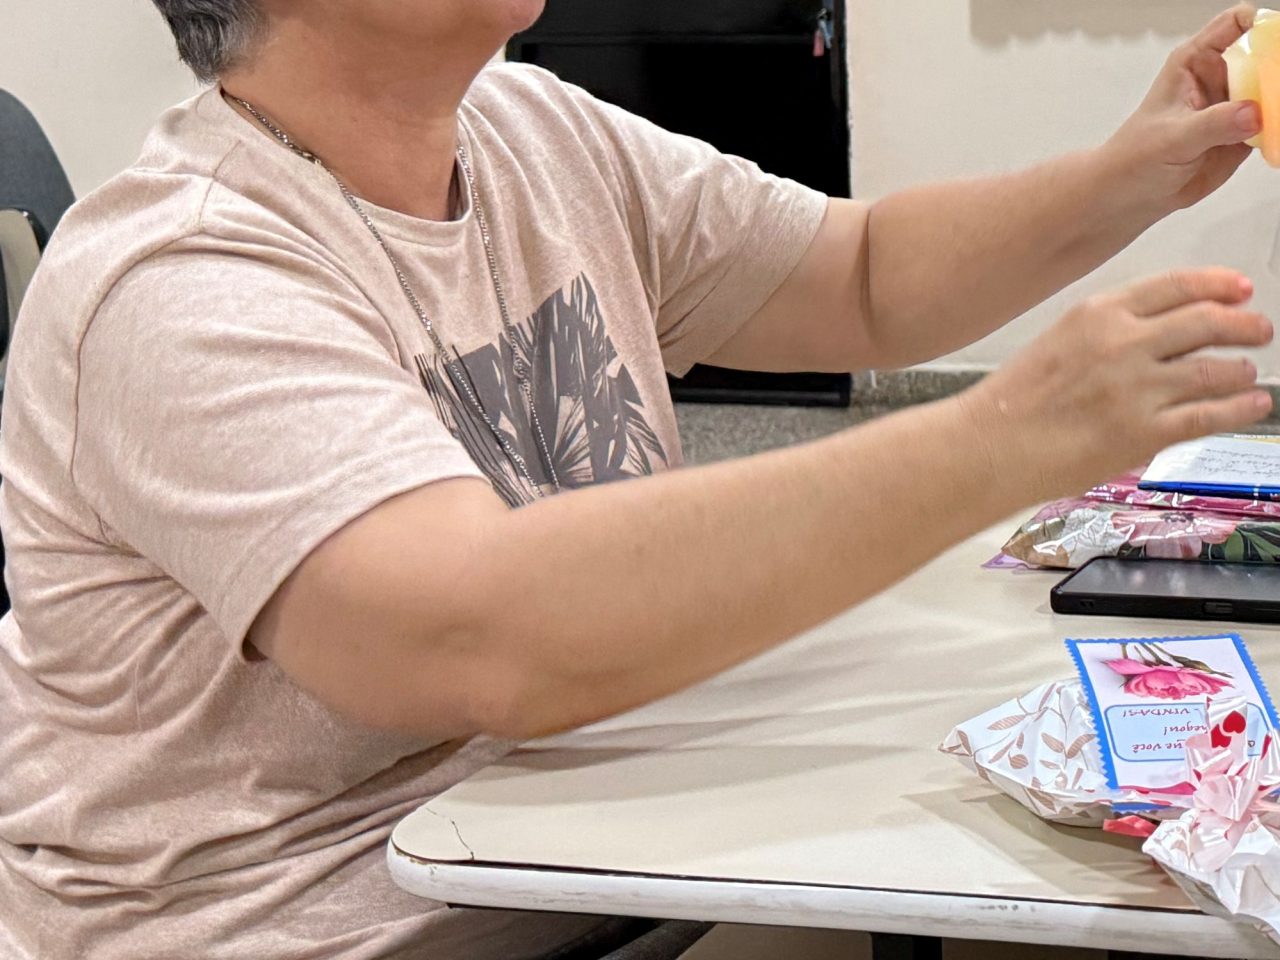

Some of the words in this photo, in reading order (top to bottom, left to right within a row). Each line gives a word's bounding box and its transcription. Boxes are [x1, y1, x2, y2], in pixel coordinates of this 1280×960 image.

[1164, 721, 1208, 735] hegou!
[1132, 742, 1162, 754] você
[1165, 739, 1186, 750] ue
